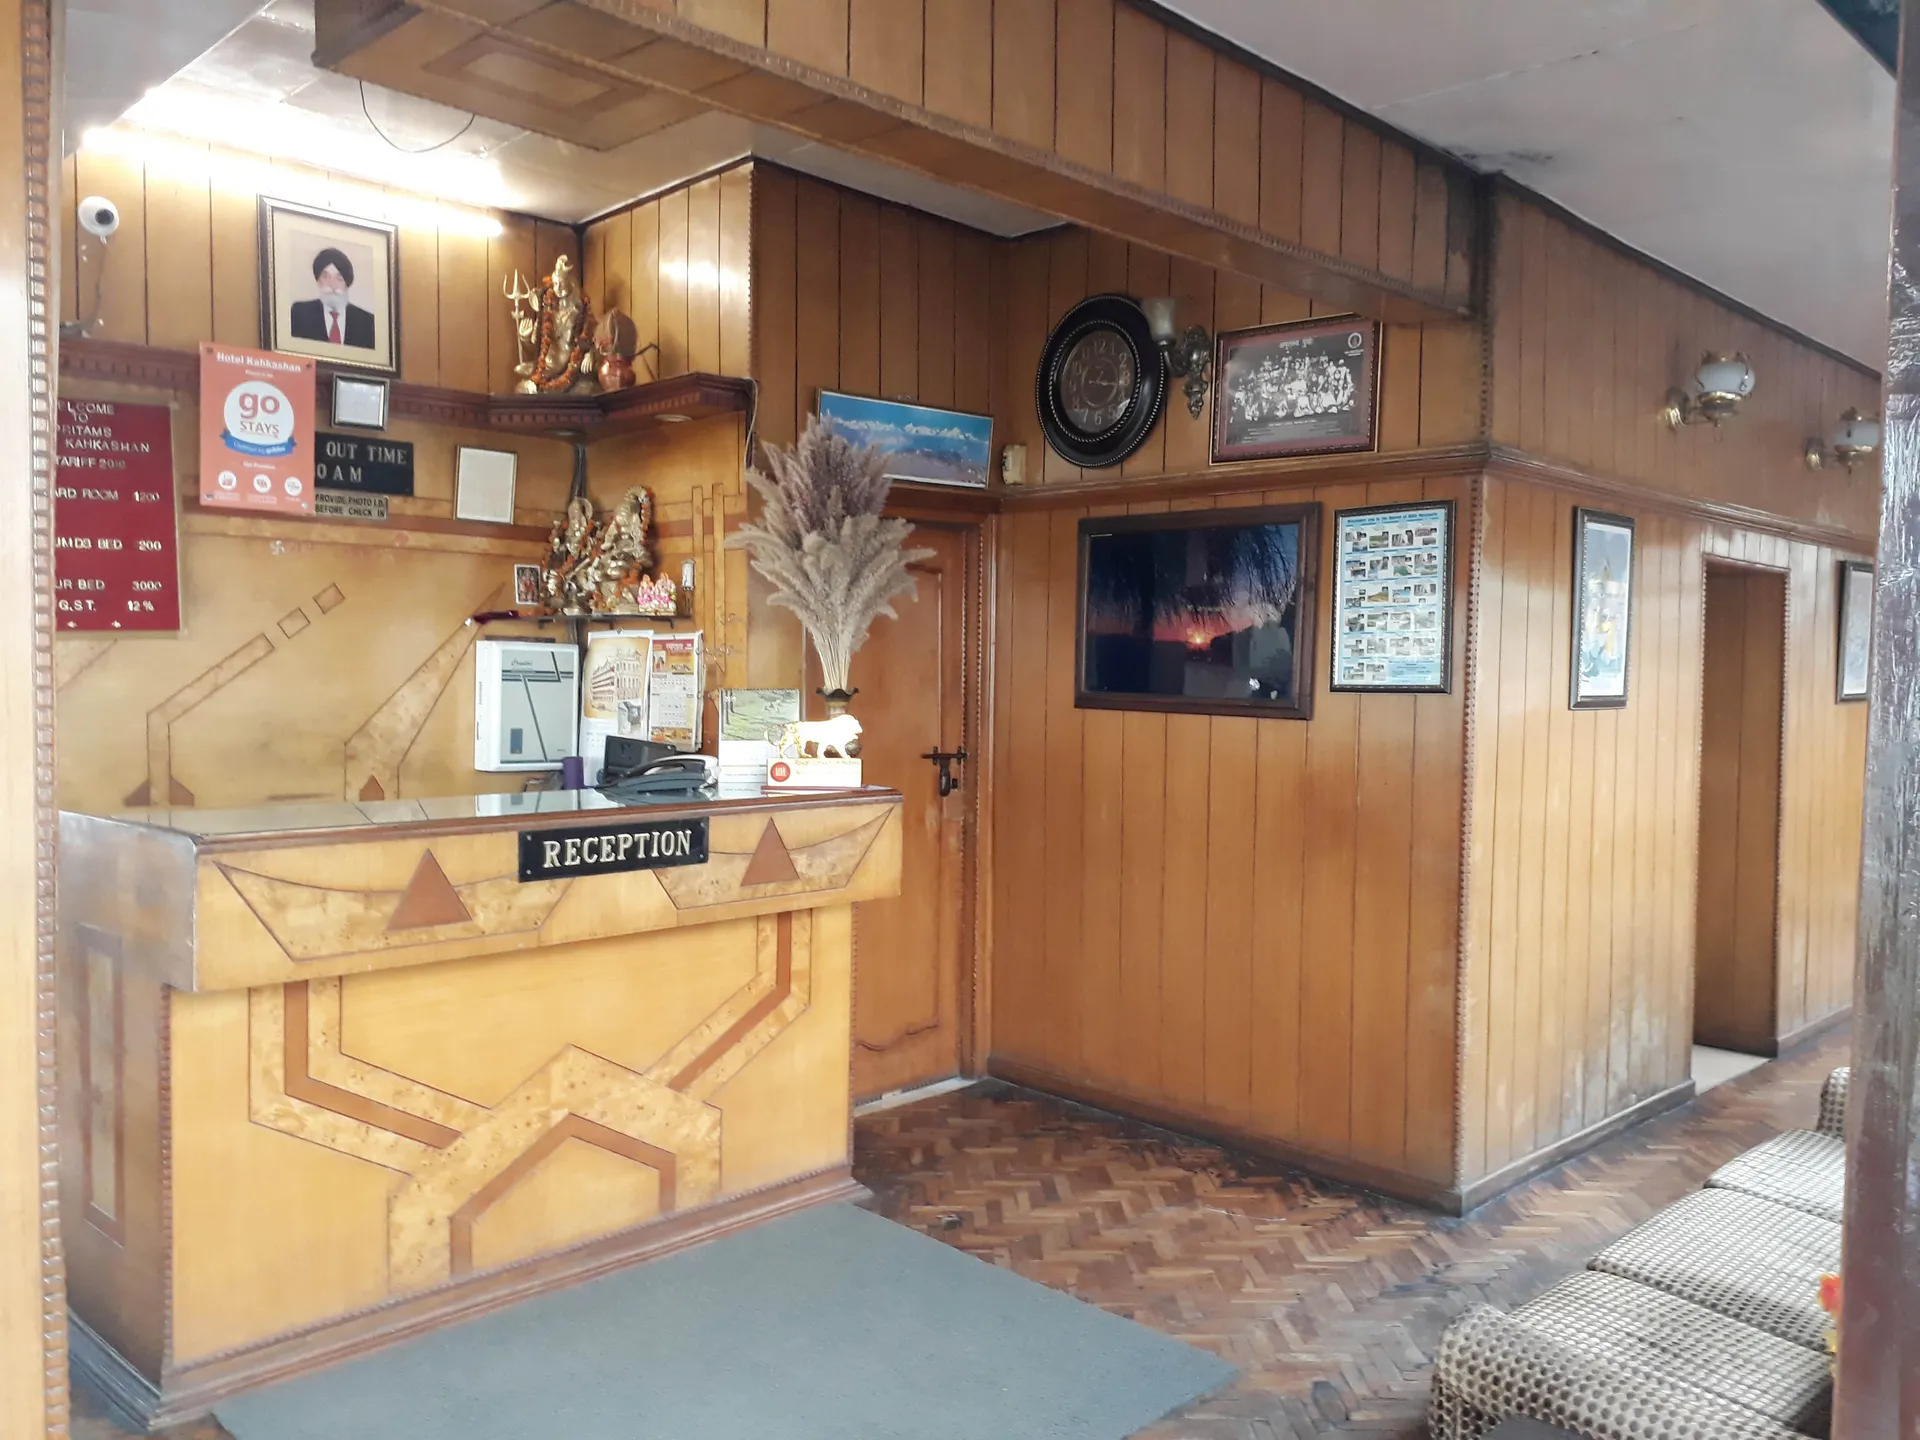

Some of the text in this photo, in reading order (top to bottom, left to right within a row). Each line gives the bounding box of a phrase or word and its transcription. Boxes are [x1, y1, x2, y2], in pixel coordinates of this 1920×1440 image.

[216, 351, 244, 364] Hotel
[57, 400, 115, 415] ELCOME
[239, 392, 280, 419] go
[70, 409, 88, 423] TO
[240, 421, 279, 434] STAYS
[65, 439, 150, 453] KAHKASHAN
[326, 440, 407, 465] OUT TIME
[316, 463, 327, 479] 0
[82, 488, 119, 501] ROOM
[348, 496, 372, 507] PHOTO
[315, 503, 385, 518] BEFORE CHECK IN
[97, 538, 123, 550] BED
[77, 578, 105, 590] BED
[543, 829, 692, 868] RECEPTION
